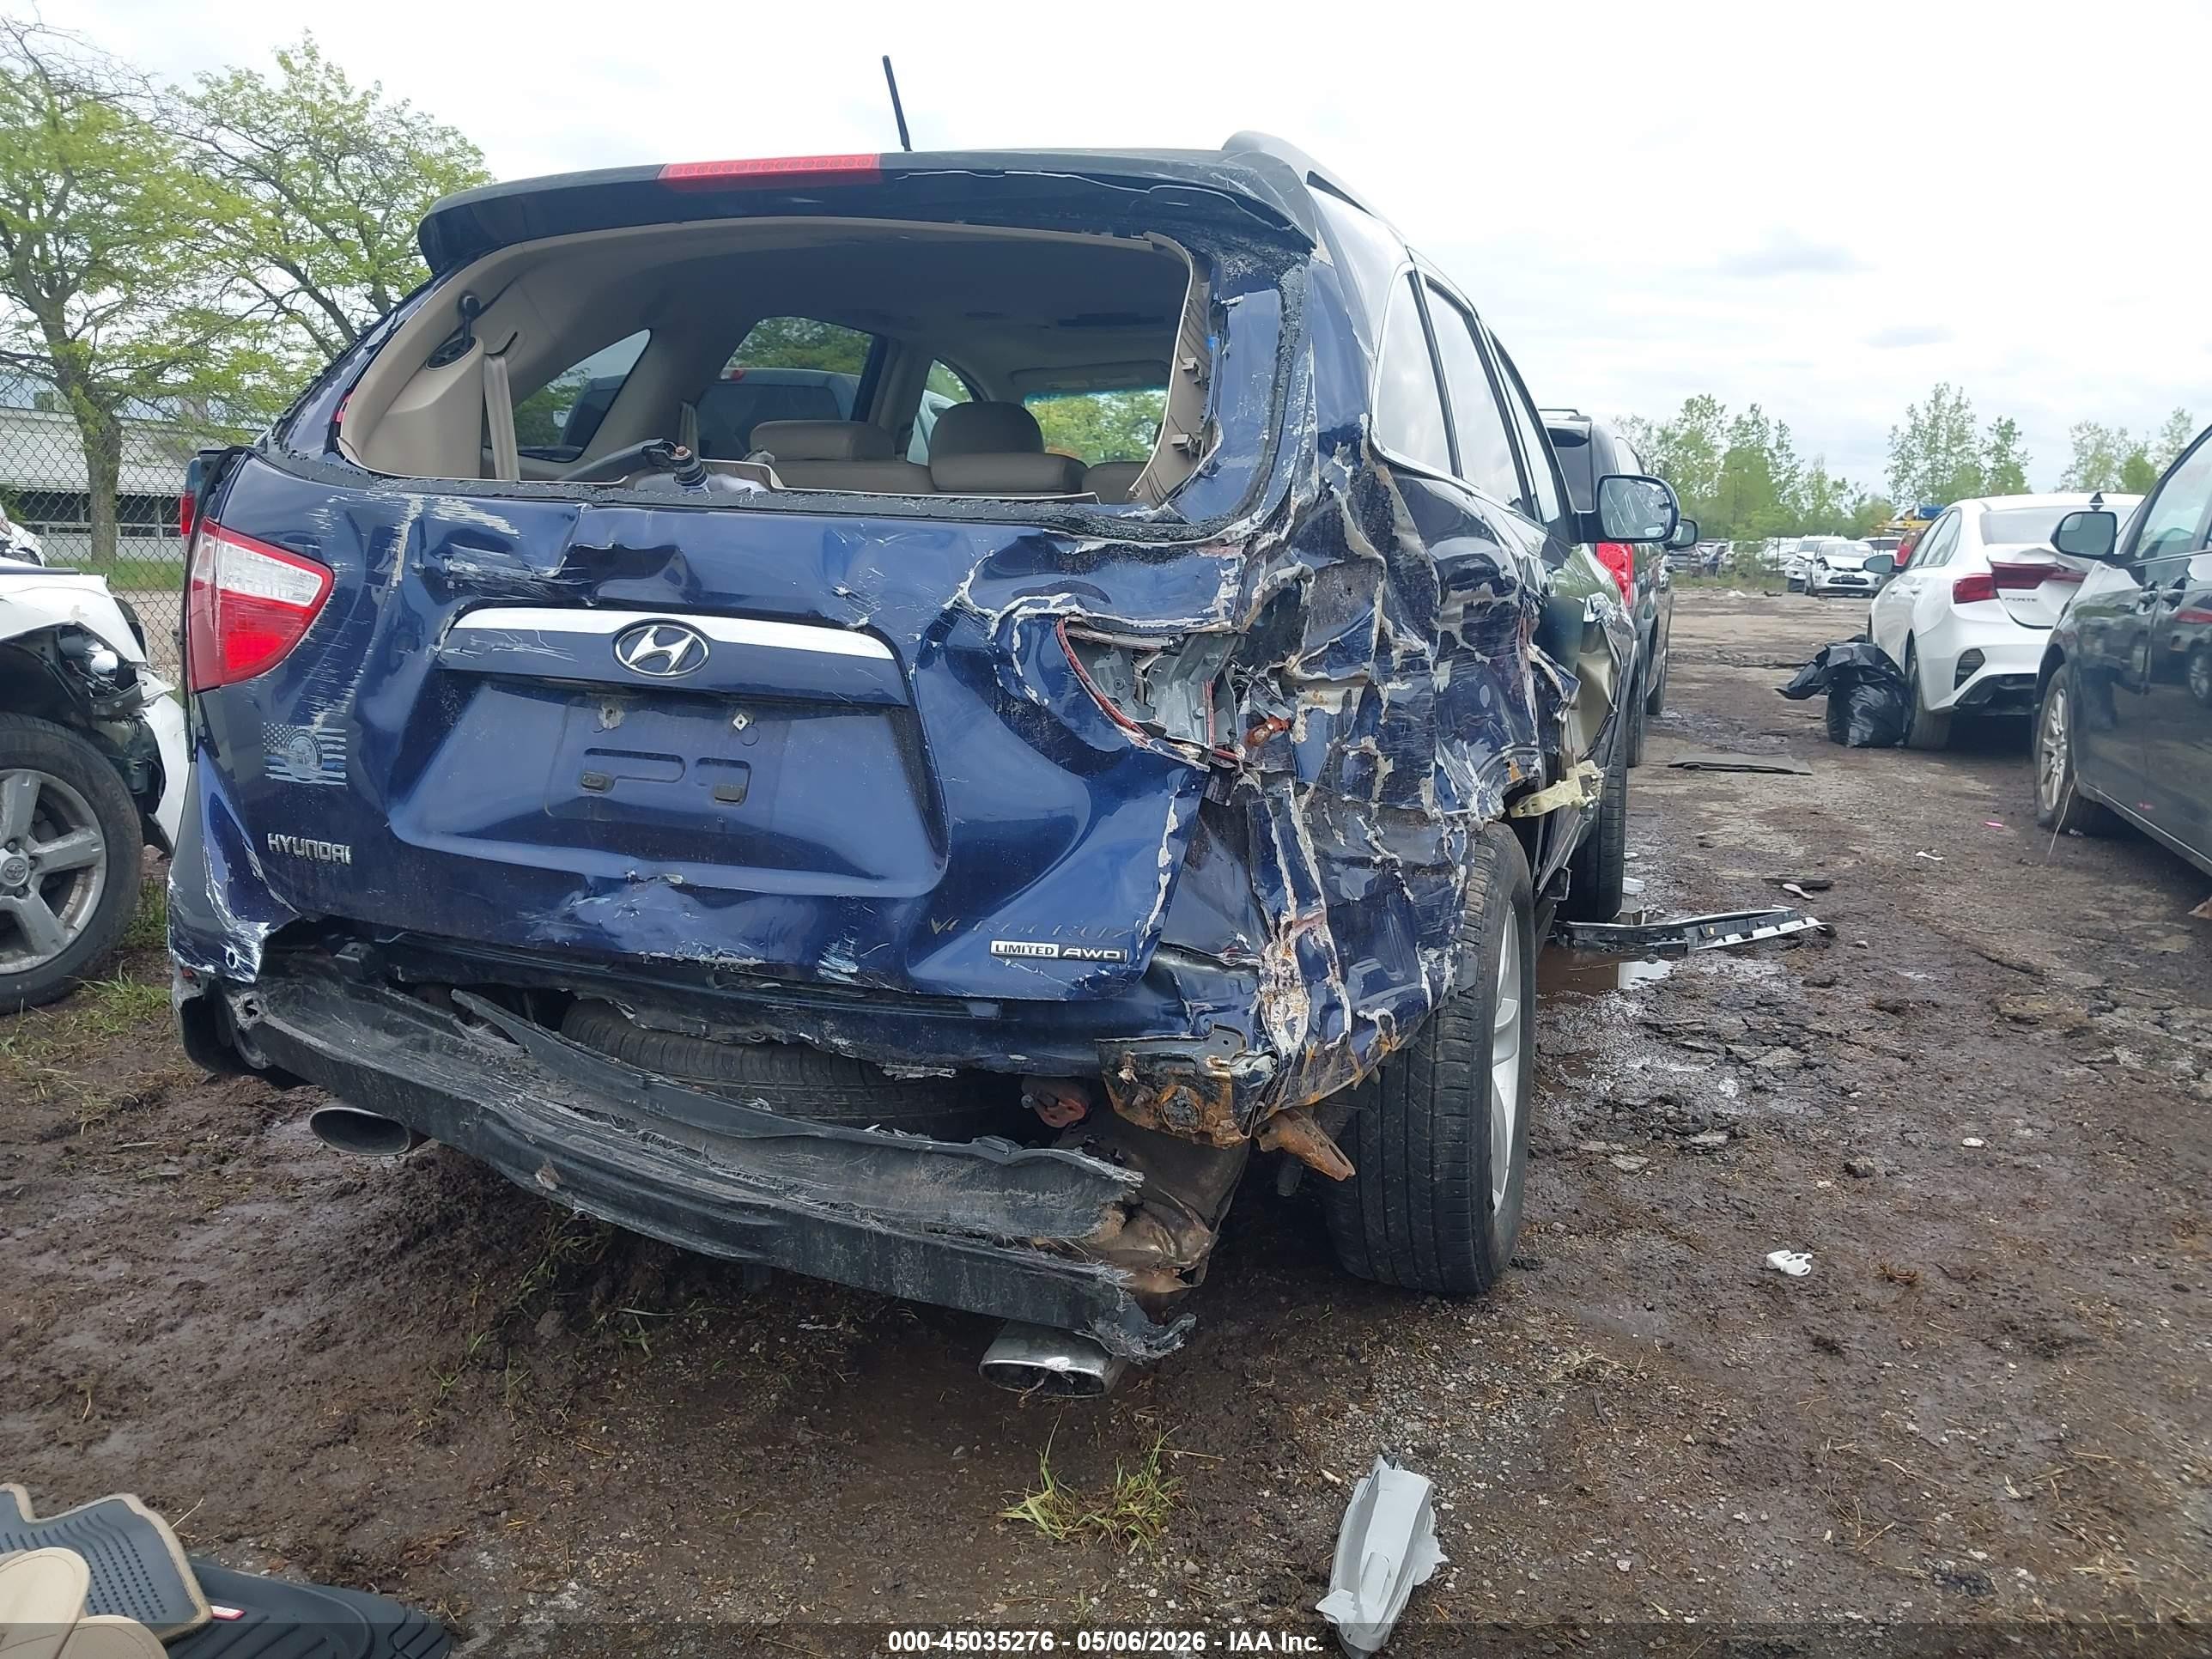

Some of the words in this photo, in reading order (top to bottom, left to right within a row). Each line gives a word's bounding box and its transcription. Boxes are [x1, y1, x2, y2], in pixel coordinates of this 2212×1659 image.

[267, 832, 351, 865] HYUNDAI
[995, 944, 1054, 956] LIMITED
[1062, 948, 1121, 959] AWD
